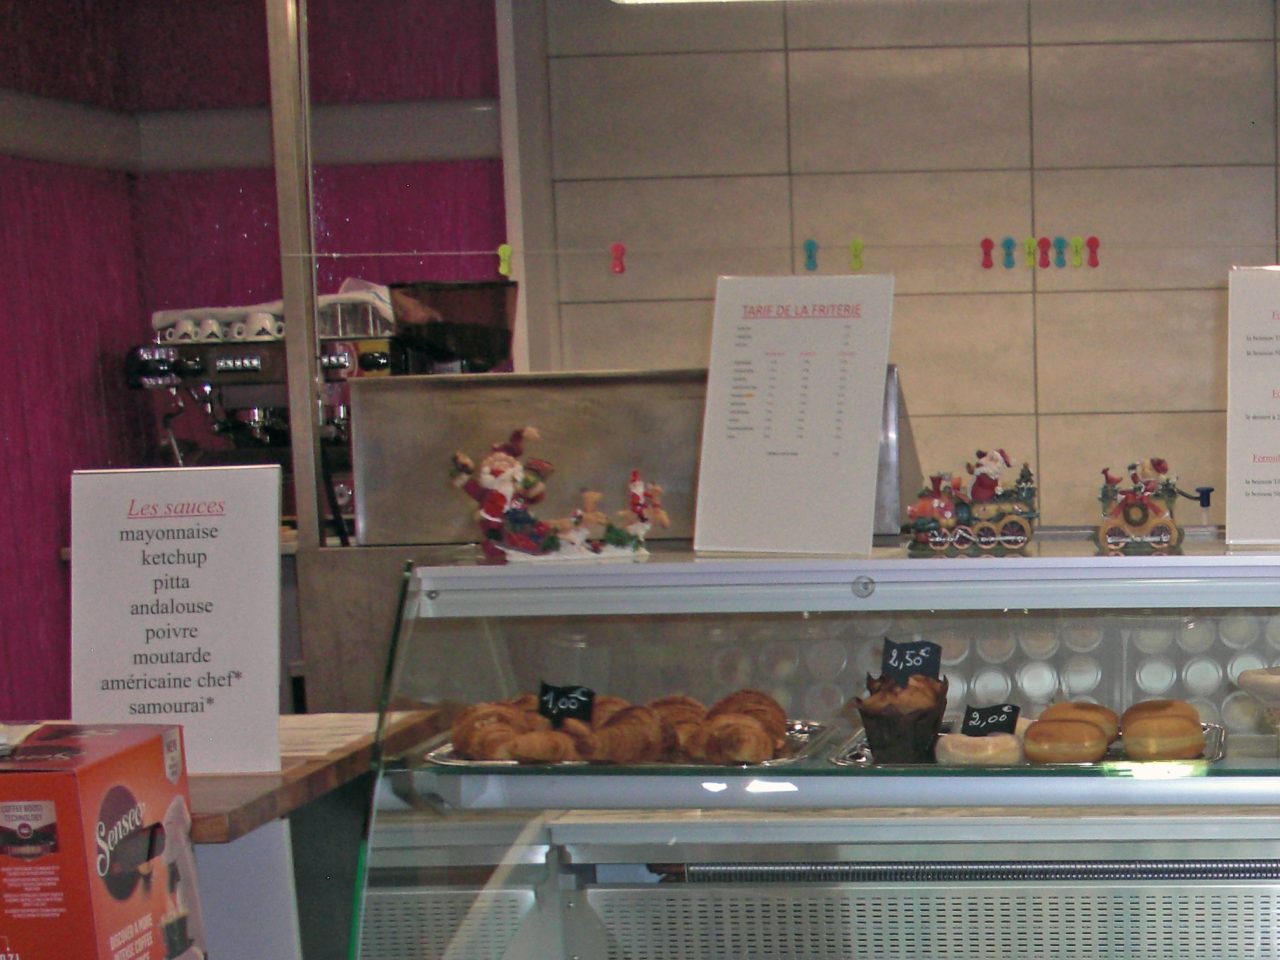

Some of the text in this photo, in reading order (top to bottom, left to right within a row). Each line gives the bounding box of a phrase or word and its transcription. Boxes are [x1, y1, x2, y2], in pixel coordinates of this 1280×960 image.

[776, 304, 793, 318] DE
[795, 304, 809, 318] LA
[127, 499, 226, 518] Les sauces
[119, 524, 219, 546] mayonnaise
[141, 549, 207, 569] ketchup
[153, 574, 190, 594] pitta
[130, 598, 214, 616] andalouse
[145, 623, 199, 645] poivre
[133, 647, 211, 665] moutarde
[101, 673, 193, 691] américaine
[96, 802, 146, 877] Senseo
